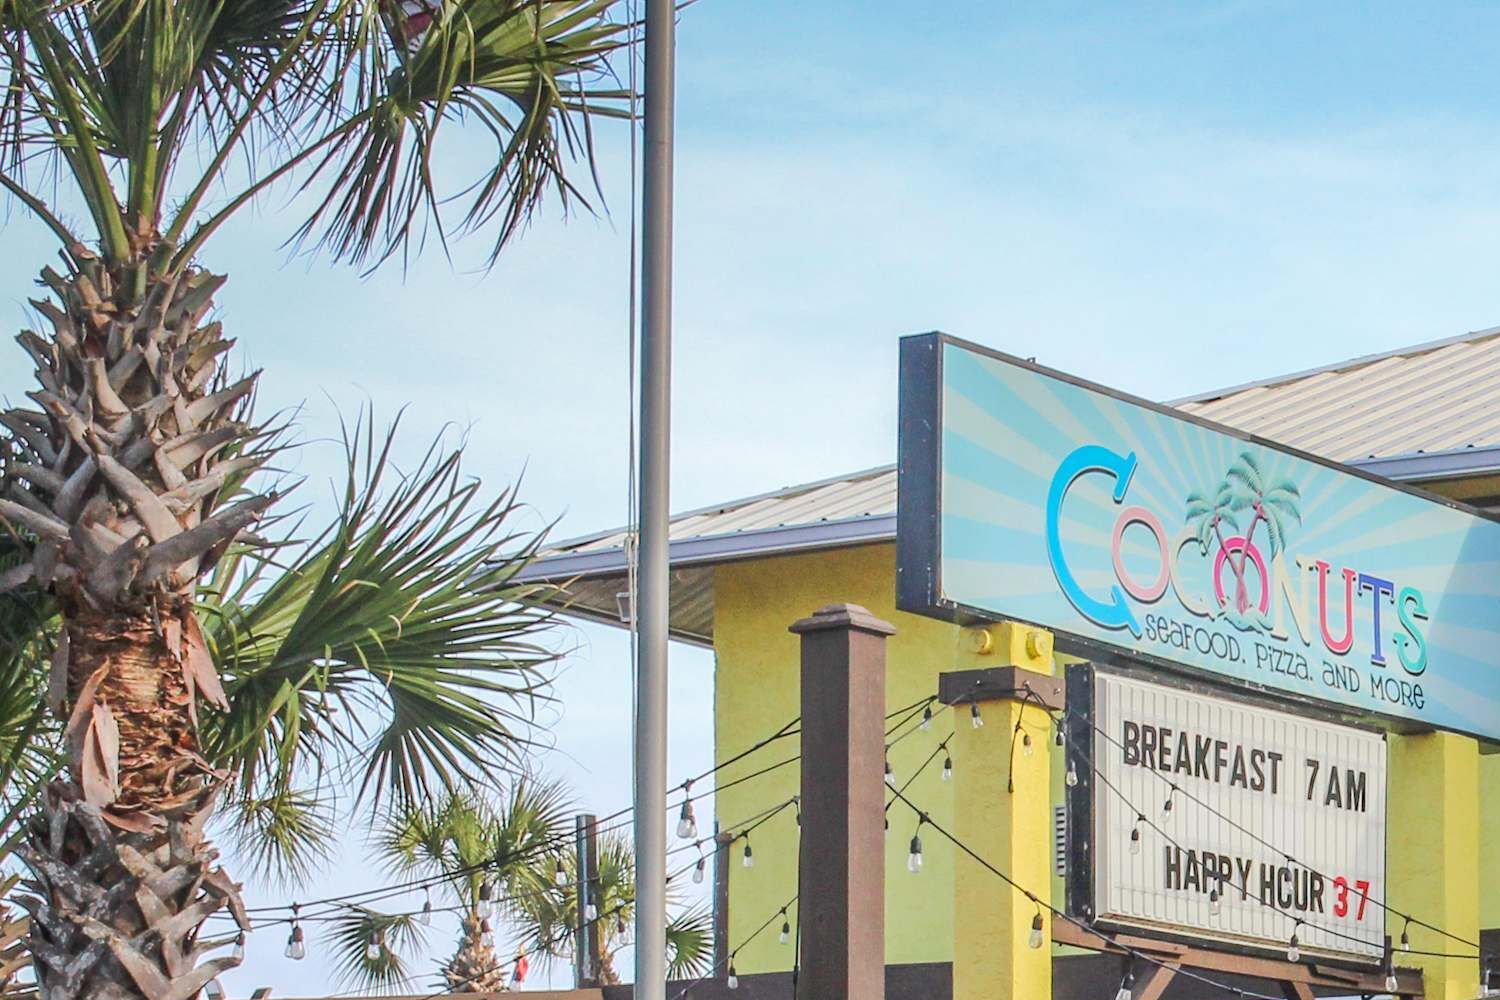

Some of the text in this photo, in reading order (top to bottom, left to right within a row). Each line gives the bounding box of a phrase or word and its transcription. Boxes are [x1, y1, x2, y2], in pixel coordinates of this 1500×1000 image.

[1046, 444, 1429, 677] COCONUTS
[1123, 720, 1283, 794] BREAKFAST
[1165, 845, 1253, 901] HAPPY
[1260, 863, 1325, 914] HOUR
